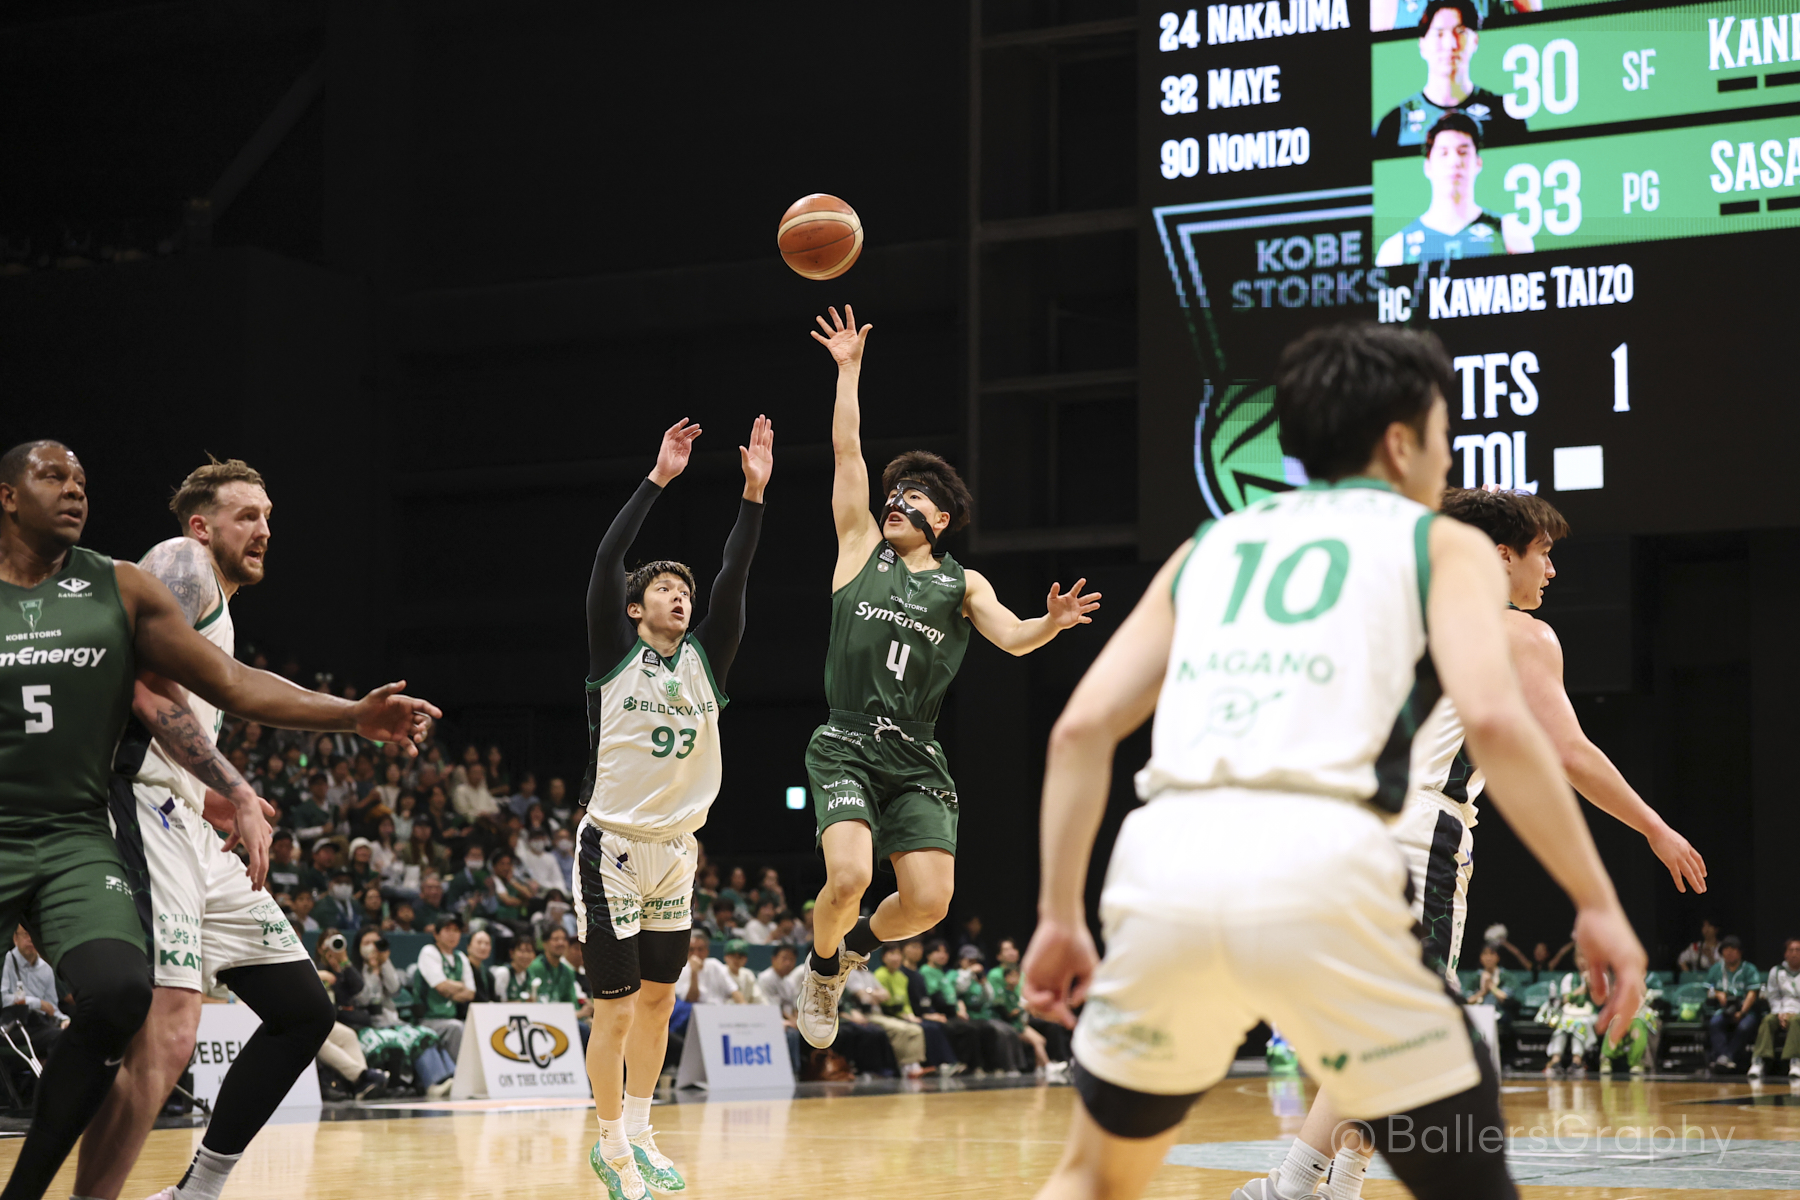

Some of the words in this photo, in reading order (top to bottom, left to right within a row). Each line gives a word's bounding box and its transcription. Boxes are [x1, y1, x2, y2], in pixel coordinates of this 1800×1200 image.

[1159, 9, 1201, 52] 24
[1207, 0, 1350, 45] NAKAJIMA
[1160, 73, 1198, 115] 32
[1207, 65, 1281, 109] MAYE
[1502, 38, 1579, 120] 30
[1622, 48, 1657, 91] SF
[1160, 137, 1200, 179] 90
[1207, 126, 1310, 174] NOMIZO
[1503, 158, 1582, 239] 33
[1622, 169, 1660, 214] PG
[1710, 137, 1800, 193] SASA
[1257, 230, 1363, 273] KOBE
[1231, 268, 1390, 312] STORKS
[1377, 285, 1412, 323] HC
[1428, 271, 1547, 319] KAWABE
[1550, 263, 1634, 309] TAIZO
[1453, 350, 1540, 420] TFS
[1611, 342, 1630, 412] 1
[1452, 431, 1539, 496] TOL
[1221, 538, 1351, 626] 10
[904, 603, 928, 613] STORKS
[6, 632, 28, 642] KOBE
[29, 629, 62, 640] STORKS
[885, 640, 911, 681] 4
[1177, 650, 1335, 684] NAGANO
[21, 685, 54, 734] 5
[651, 726, 697, 759] 93
[828, 797, 865, 811] KPMG
[722, 1034, 772, 1067] Inest
[499, 1073, 514, 1088] ON
[516, 1073, 539, 1087] THE
